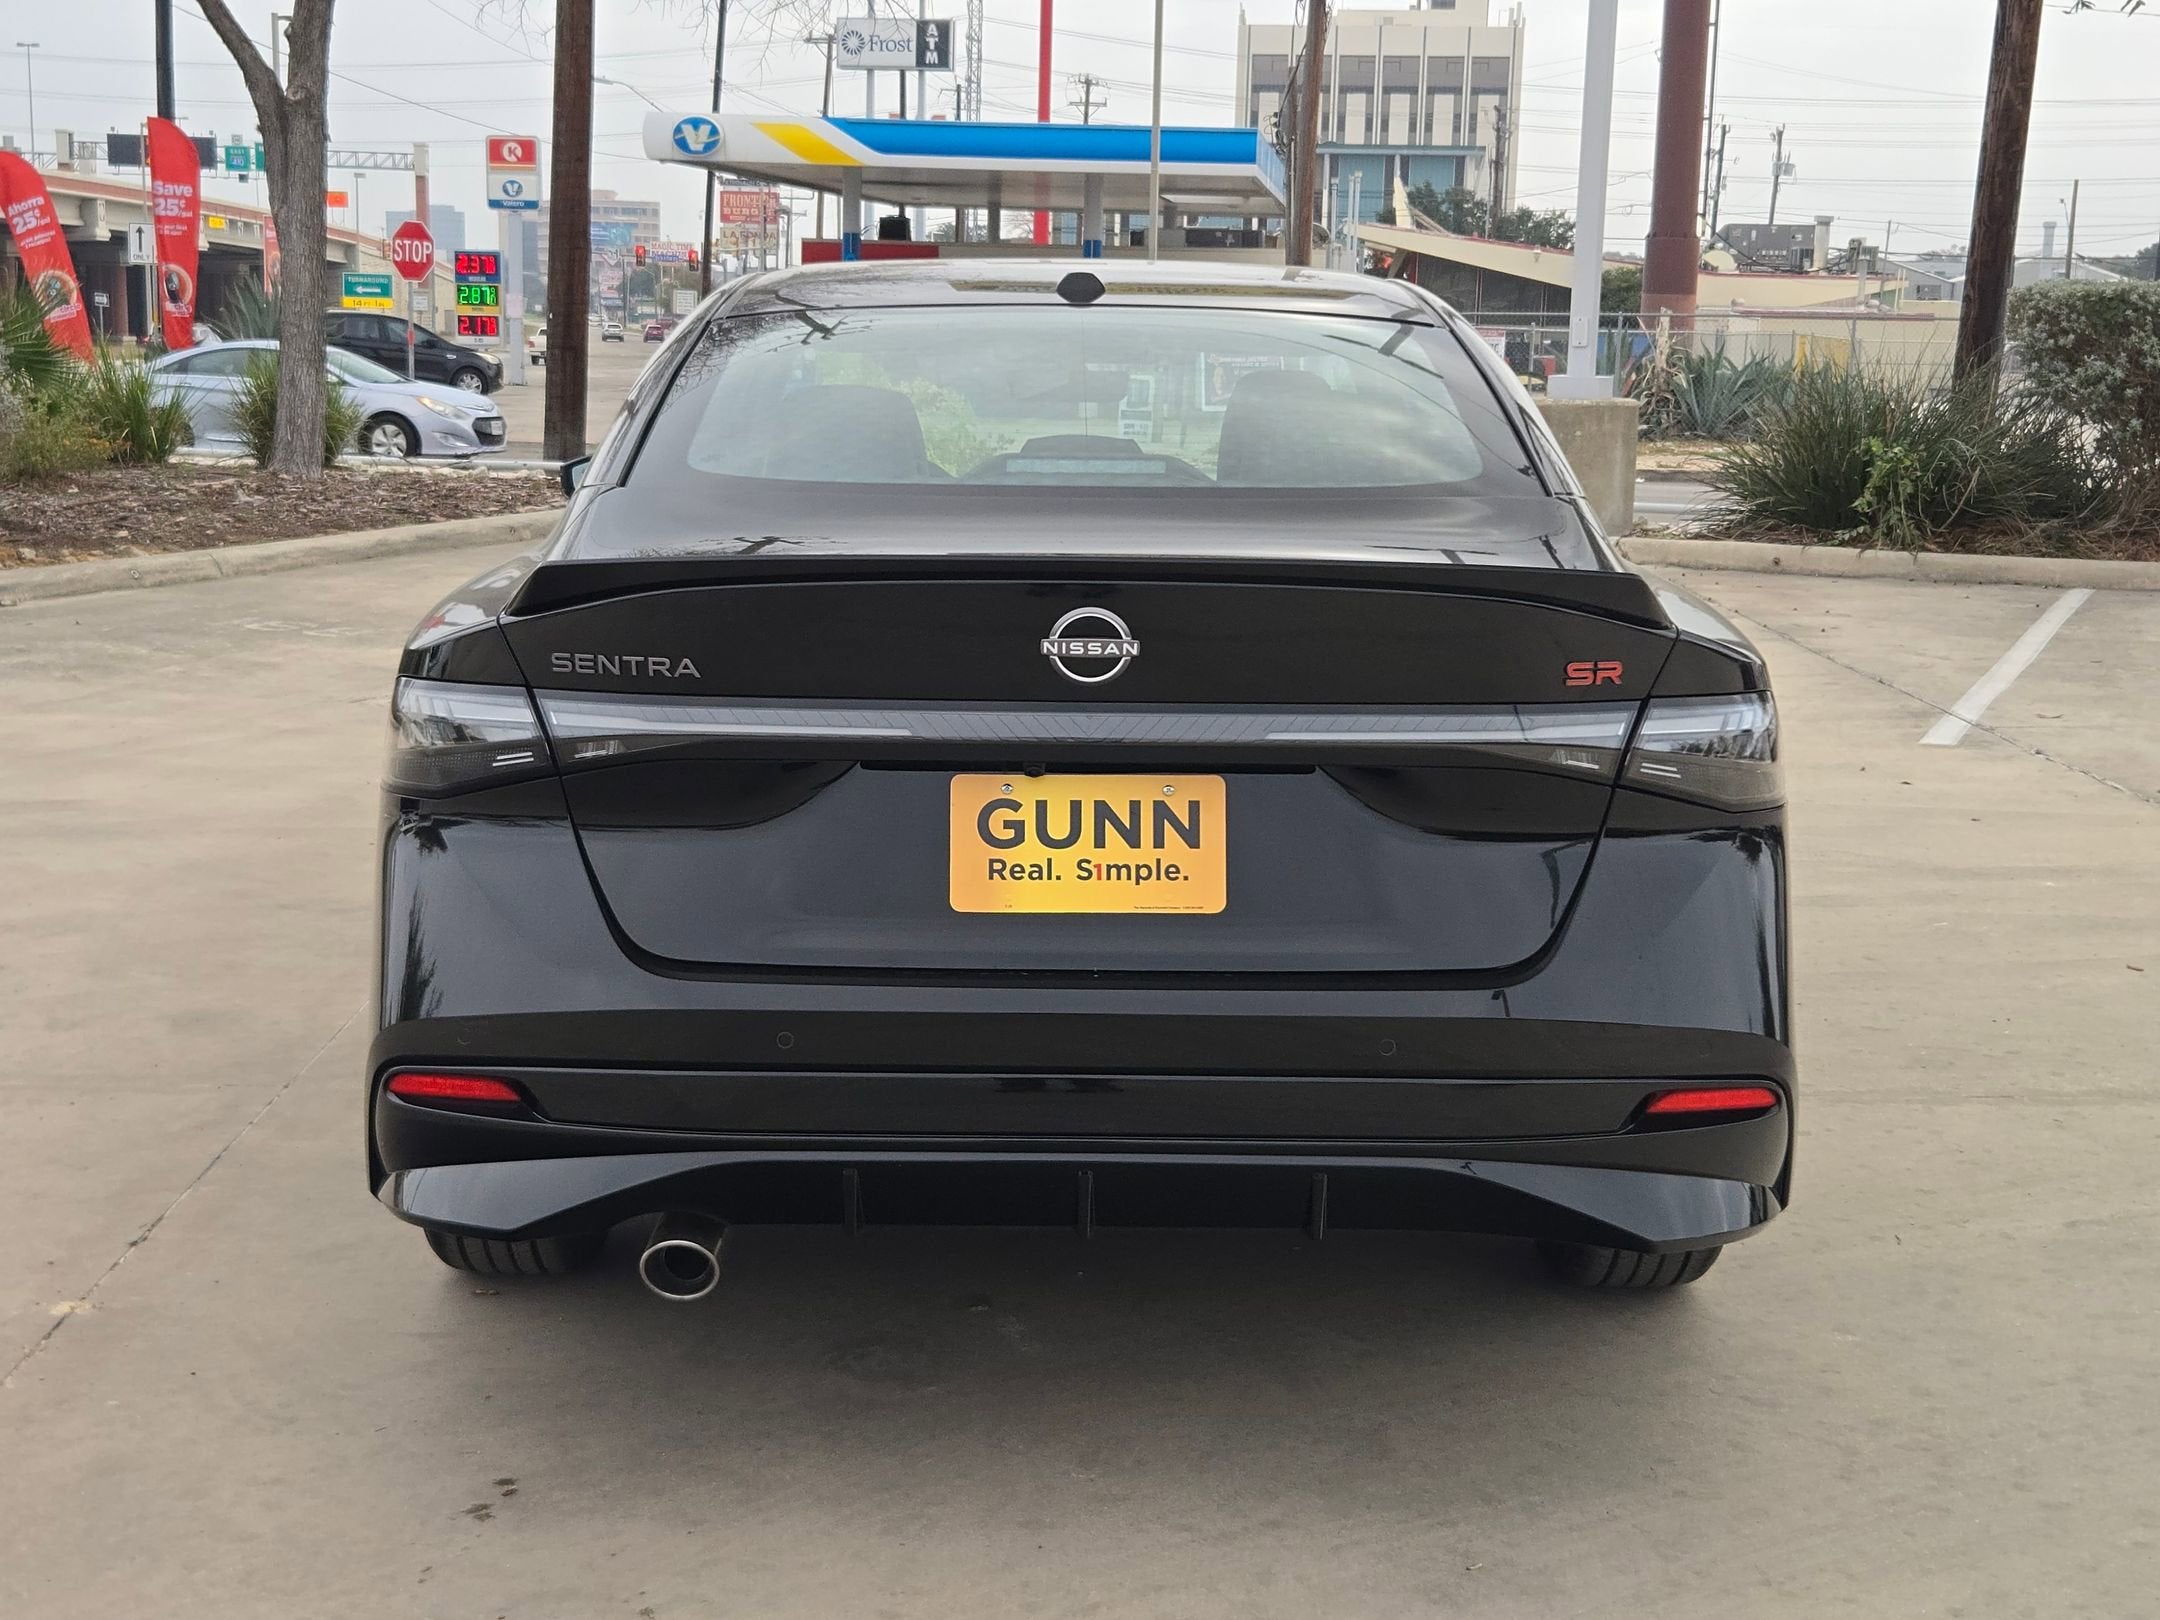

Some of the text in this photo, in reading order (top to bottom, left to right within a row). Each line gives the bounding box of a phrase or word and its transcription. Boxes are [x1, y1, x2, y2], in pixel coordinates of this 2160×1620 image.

[869, 34, 913, 52] Frost
[924, 23, 939, 65] ATM
[152, 180, 193, 197] Save
[8, 196, 45, 217] Ahorra
[502, 199, 525, 207] Valero
[394, 240, 432, 263] STOP
[348, 276, 388, 284] TURNAROUND
[1043, 642, 1138, 655] NISSAN
[551, 652, 701, 678] SENTRA
[1565, 661, 1623, 686] SR
[977, 798, 1200, 849] GUNN
[988, 858, 1061, 881] Real.
